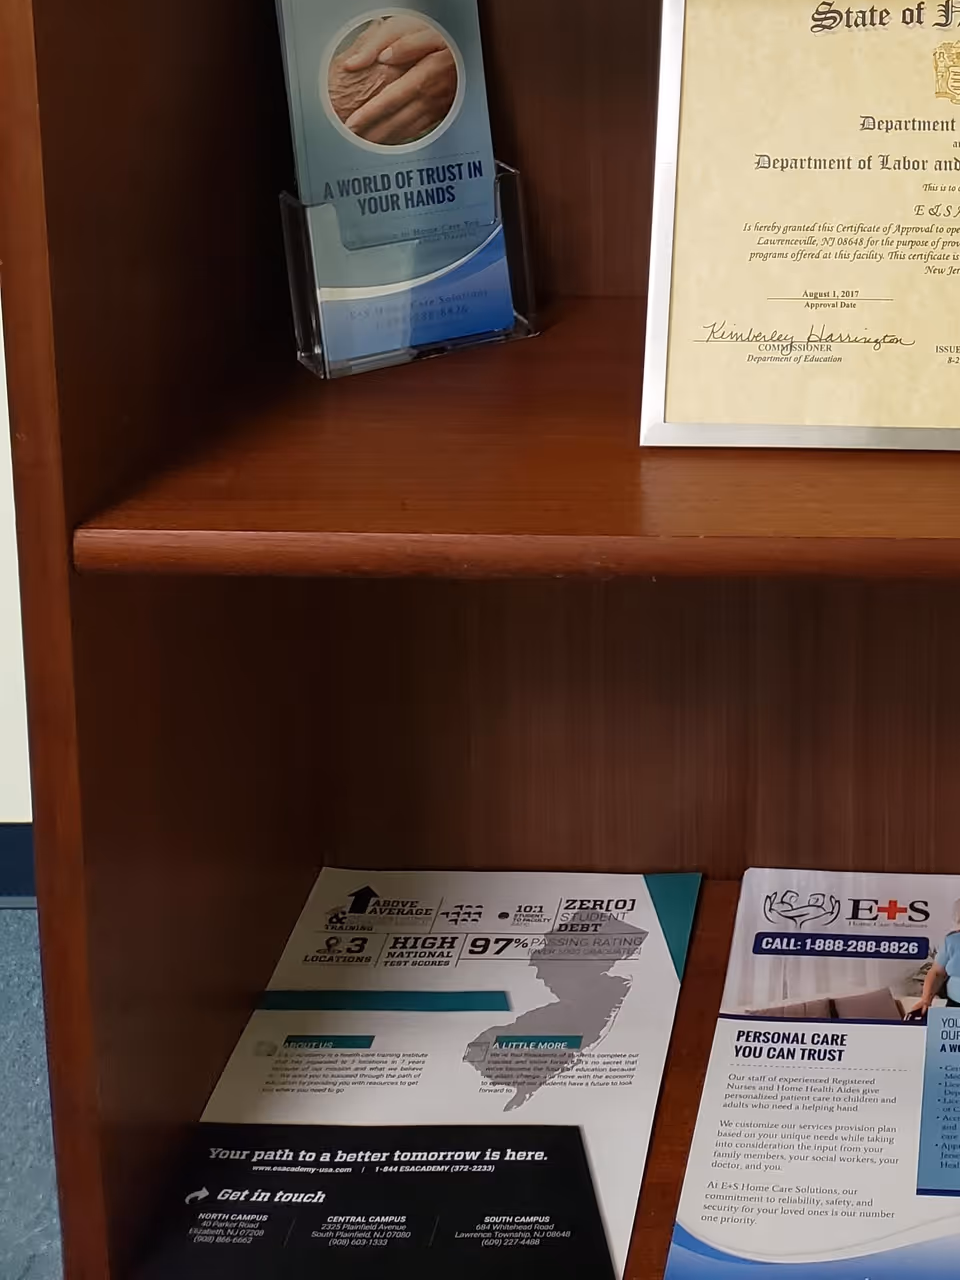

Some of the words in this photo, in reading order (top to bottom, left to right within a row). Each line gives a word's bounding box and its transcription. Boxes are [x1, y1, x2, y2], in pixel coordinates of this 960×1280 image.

[810, 0, 891, 35] State
[900, 1, 925, 27] of
[859, 115, 956, 133] Department
[754, 153, 852, 172] Department
[857, 154, 872, 170] of
[877, 154, 928, 170] Labor
[323, 181, 334, 200] A
[336, 173, 391, 200] WORLD
[394, 170, 414, 190] OF
[417, 164, 464, 188] TRUST
[467, 160, 483, 180] IN
[357, 190, 402, 217] YOUR
[404, 185, 456, 210] HANDS
[913, 204, 925, 217] E
[928, 204, 942, 218] &
[943, 204, 953, 217] S
[935, 345, 960, 354] ISSUE
[846, 897, 930, 922] E+S
[388, 936, 459, 950] HIGH
[467, 937, 528, 956] 97%
[761, 936, 802, 951] CALL:
[804, 938, 919, 955] 1-888-288-8826
[302, 955, 372, 964] LOCATIONS
[386, 951, 454, 959] NATIONAL
[382, 960, 408, 968] TEST
[736, 1030, 807, 1046] PERSONAL
[810, 1031, 848, 1047] CARE
[733, 1044, 762, 1060] YOU
[764, 1045, 796, 1061] CAN
[799, 1047, 845, 1062] TRUST
[208, 1148, 251, 1160] Your
[251, 1148, 295, 1162] path
[298, 1150, 316, 1162] to
[319, 1153, 331, 1162] a
[333, 1149, 389, 1163] better
[393, 1149, 482, 1162] tomorrow
[485, 1149, 500, 1160] is
[504, 1148, 548, 1161] here.
[217, 1188, 251, 1203] Get
[252, 1189, 272, 1203] in
[272, 1189, 327, 1204] touch
